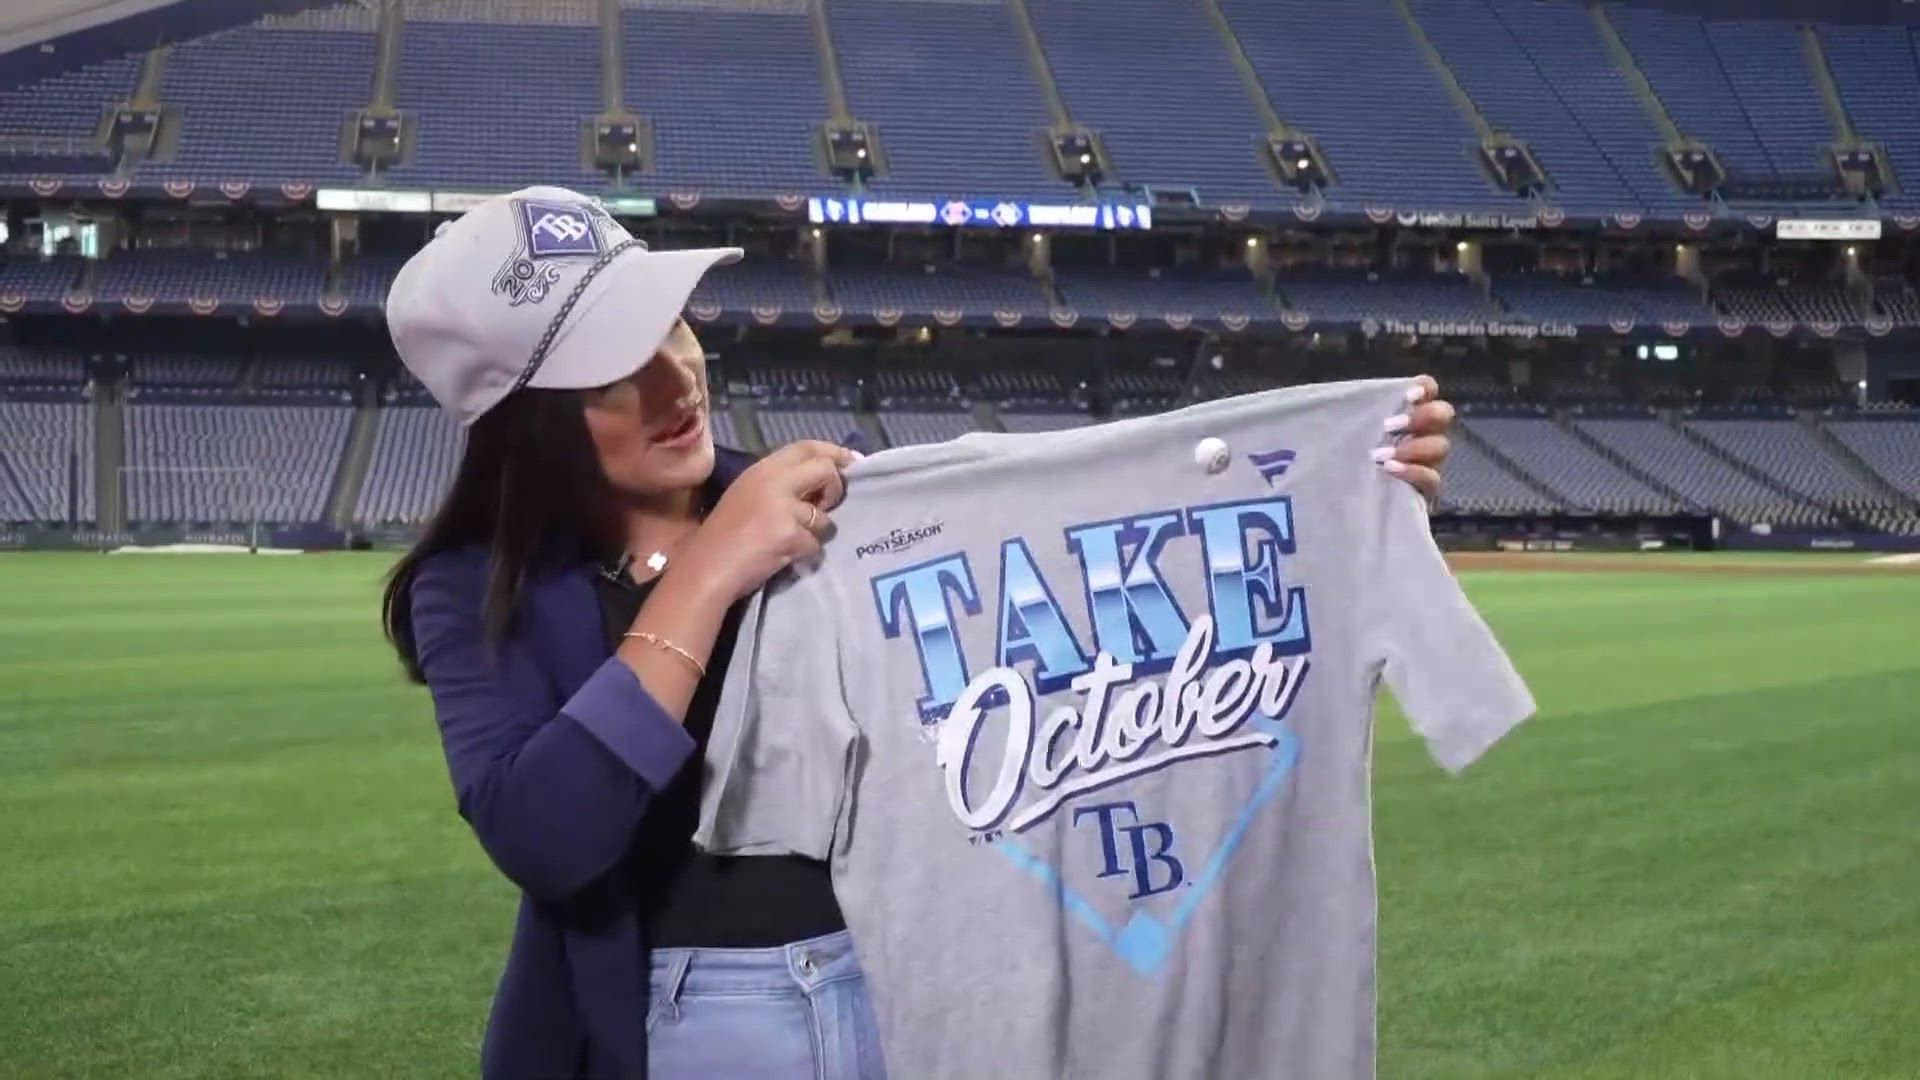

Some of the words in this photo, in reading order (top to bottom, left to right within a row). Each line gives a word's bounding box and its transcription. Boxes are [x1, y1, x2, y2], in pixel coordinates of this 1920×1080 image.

[532, 212, 590, 243] TB
[1385, 320, 1415, 335] The
[1418, 320, 1485, 336] Baldwin
[1487, 321, 1539, 340] Group
[1541, 320, 1578, 338] Club
[855, 523, 942, 560] POSTSEASON
[870, 494, 1311, 724] TAKE
[936, 614, 1309, 830] October
[1073, 800, 1184, 902] TB
